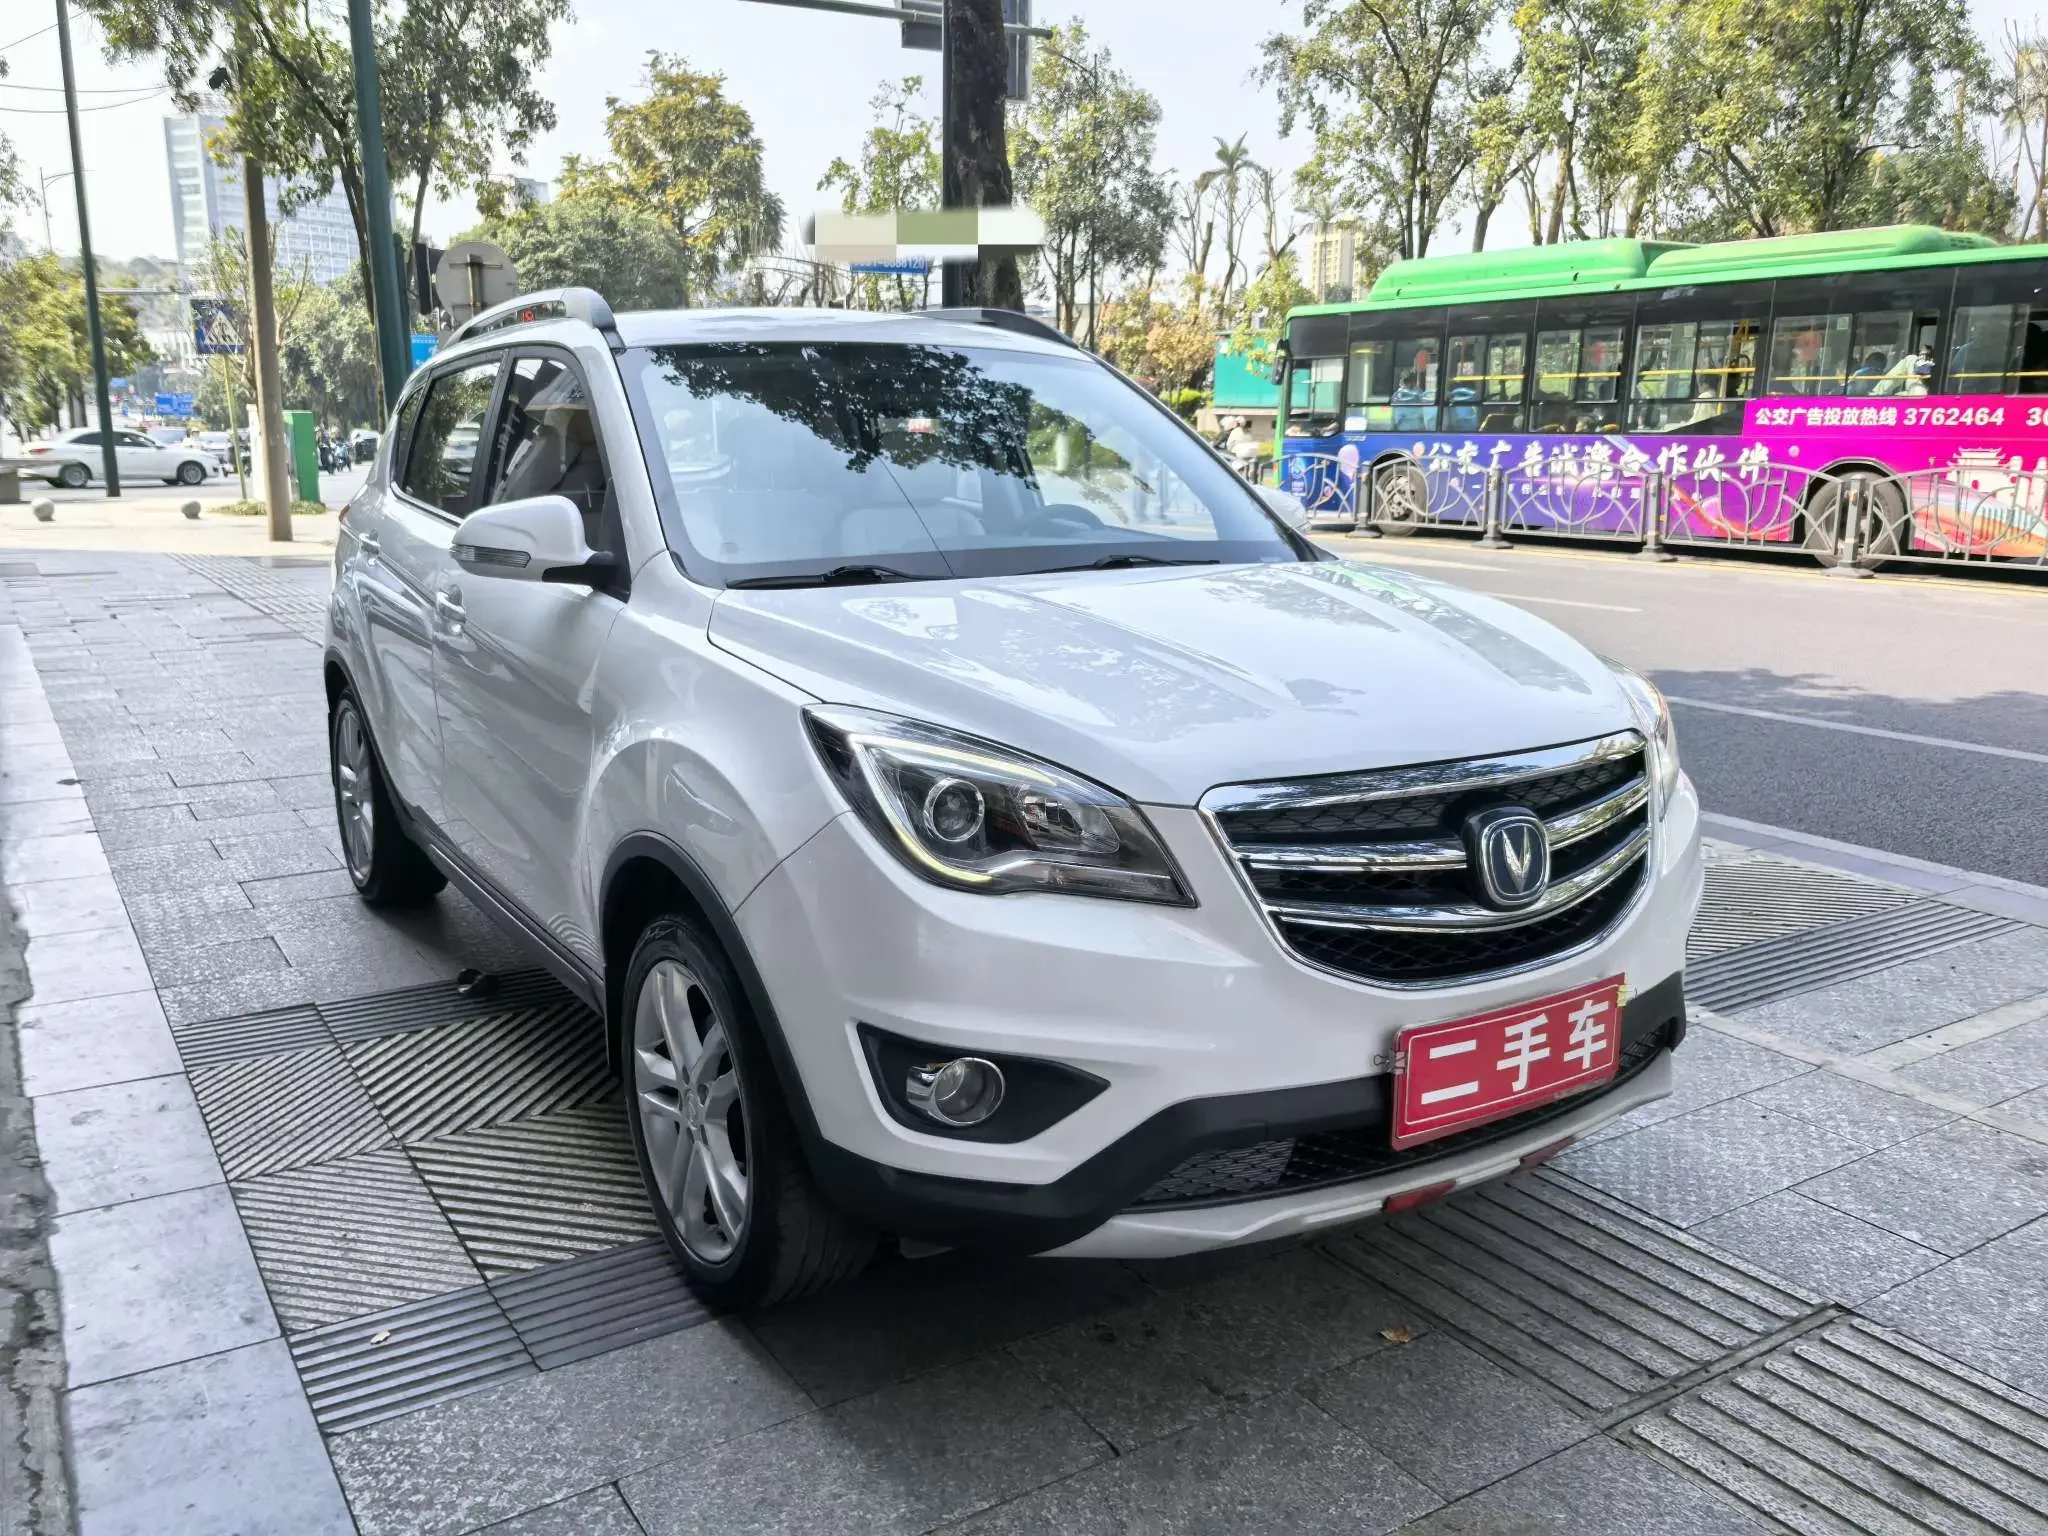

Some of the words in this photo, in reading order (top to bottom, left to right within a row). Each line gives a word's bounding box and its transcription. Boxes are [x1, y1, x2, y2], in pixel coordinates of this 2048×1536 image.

[1755, 407, 1897, 426] 公交广告投放热线
[1903, 407, 2005, 426] 3762464
[1421, 1000, 1609, 1104] 二手车
